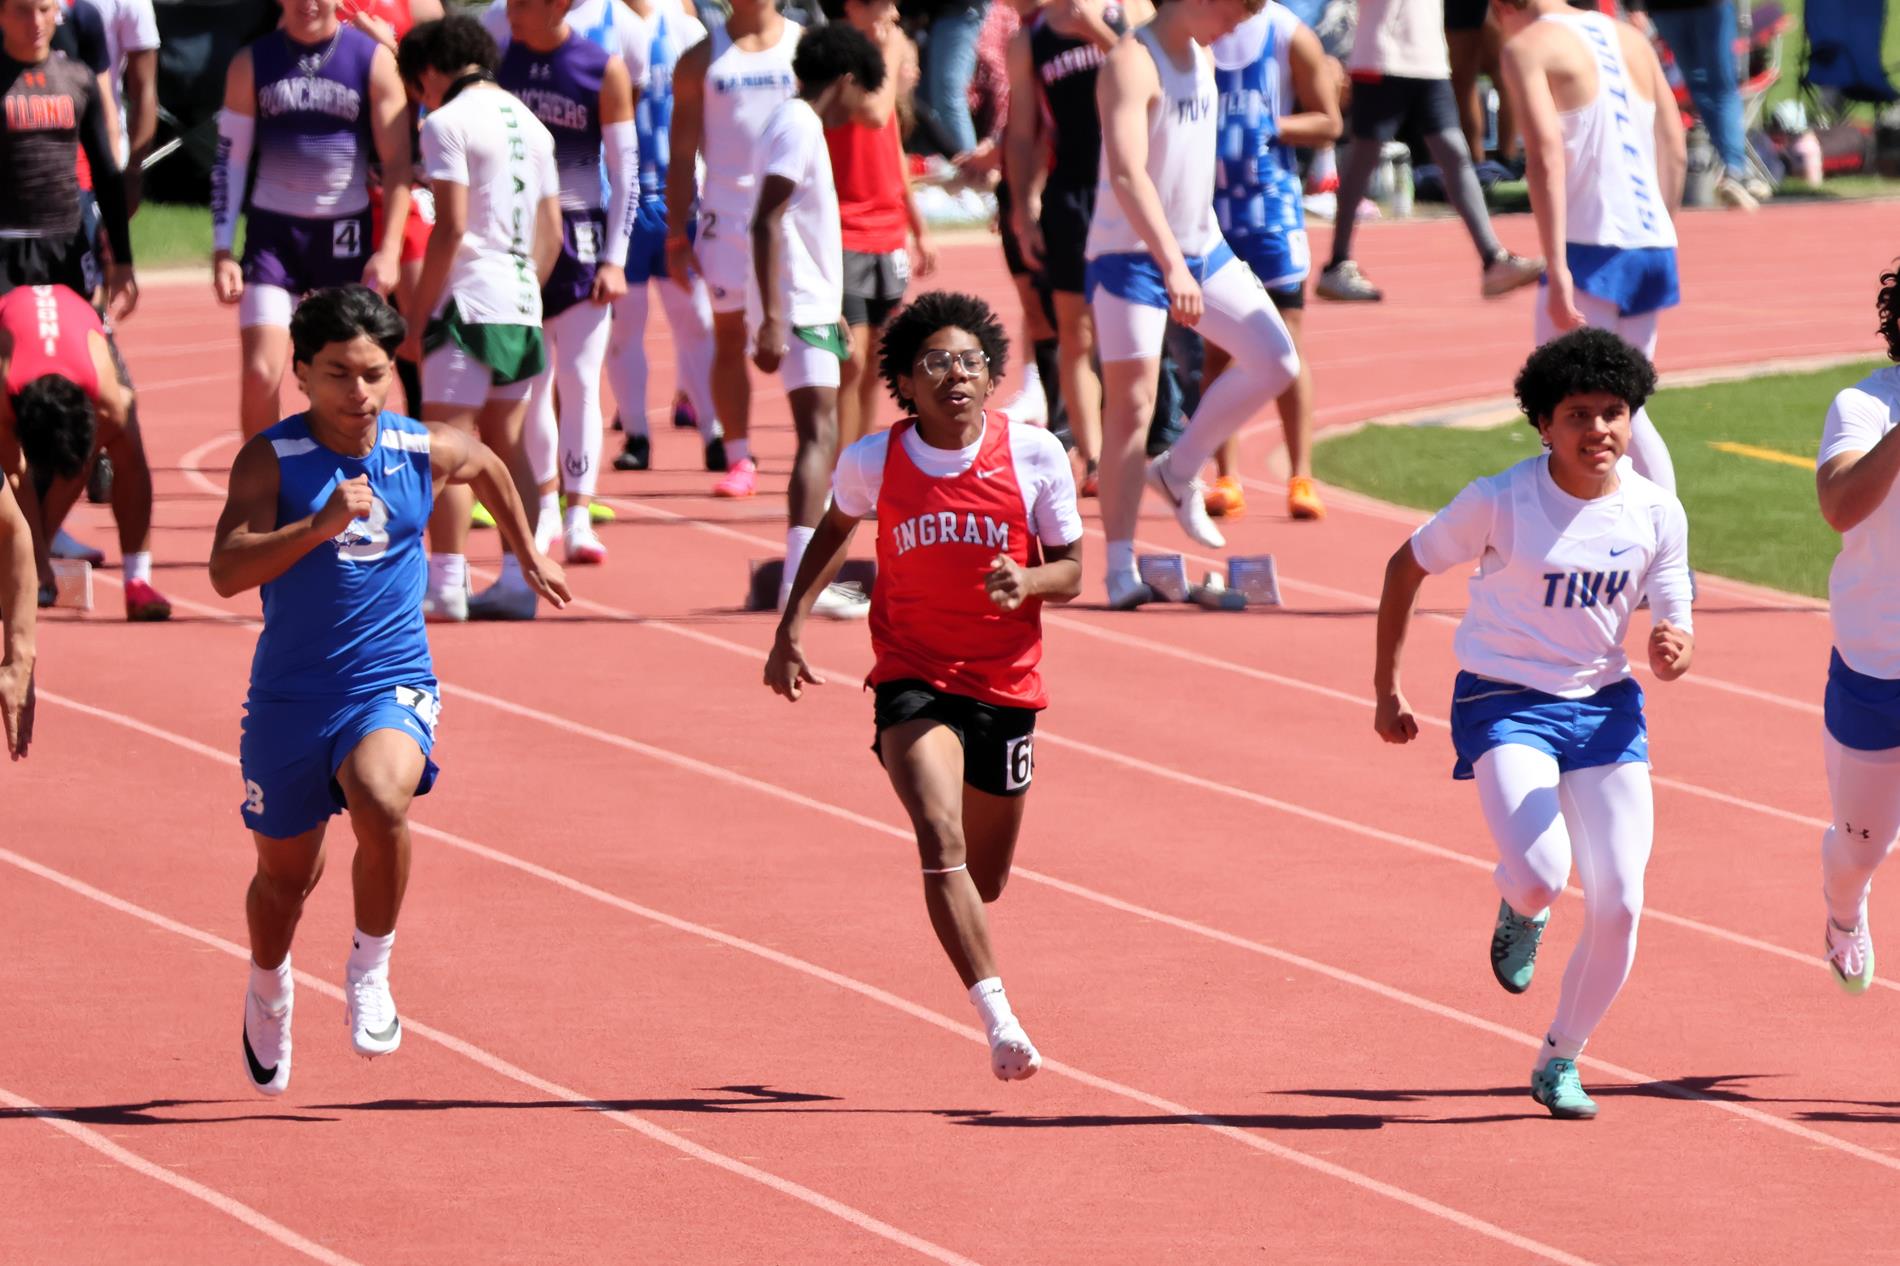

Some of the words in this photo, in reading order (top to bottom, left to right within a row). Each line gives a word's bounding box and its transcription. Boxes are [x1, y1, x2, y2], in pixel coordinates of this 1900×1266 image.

[335, 221, 359, 253] 4
[702, 211, 717, 239] 2
[892, 511, 1010, 556] INGRAM
[1543, 569, 1631, 608] TIVY
[1011, 739, 1030, 784] 6
